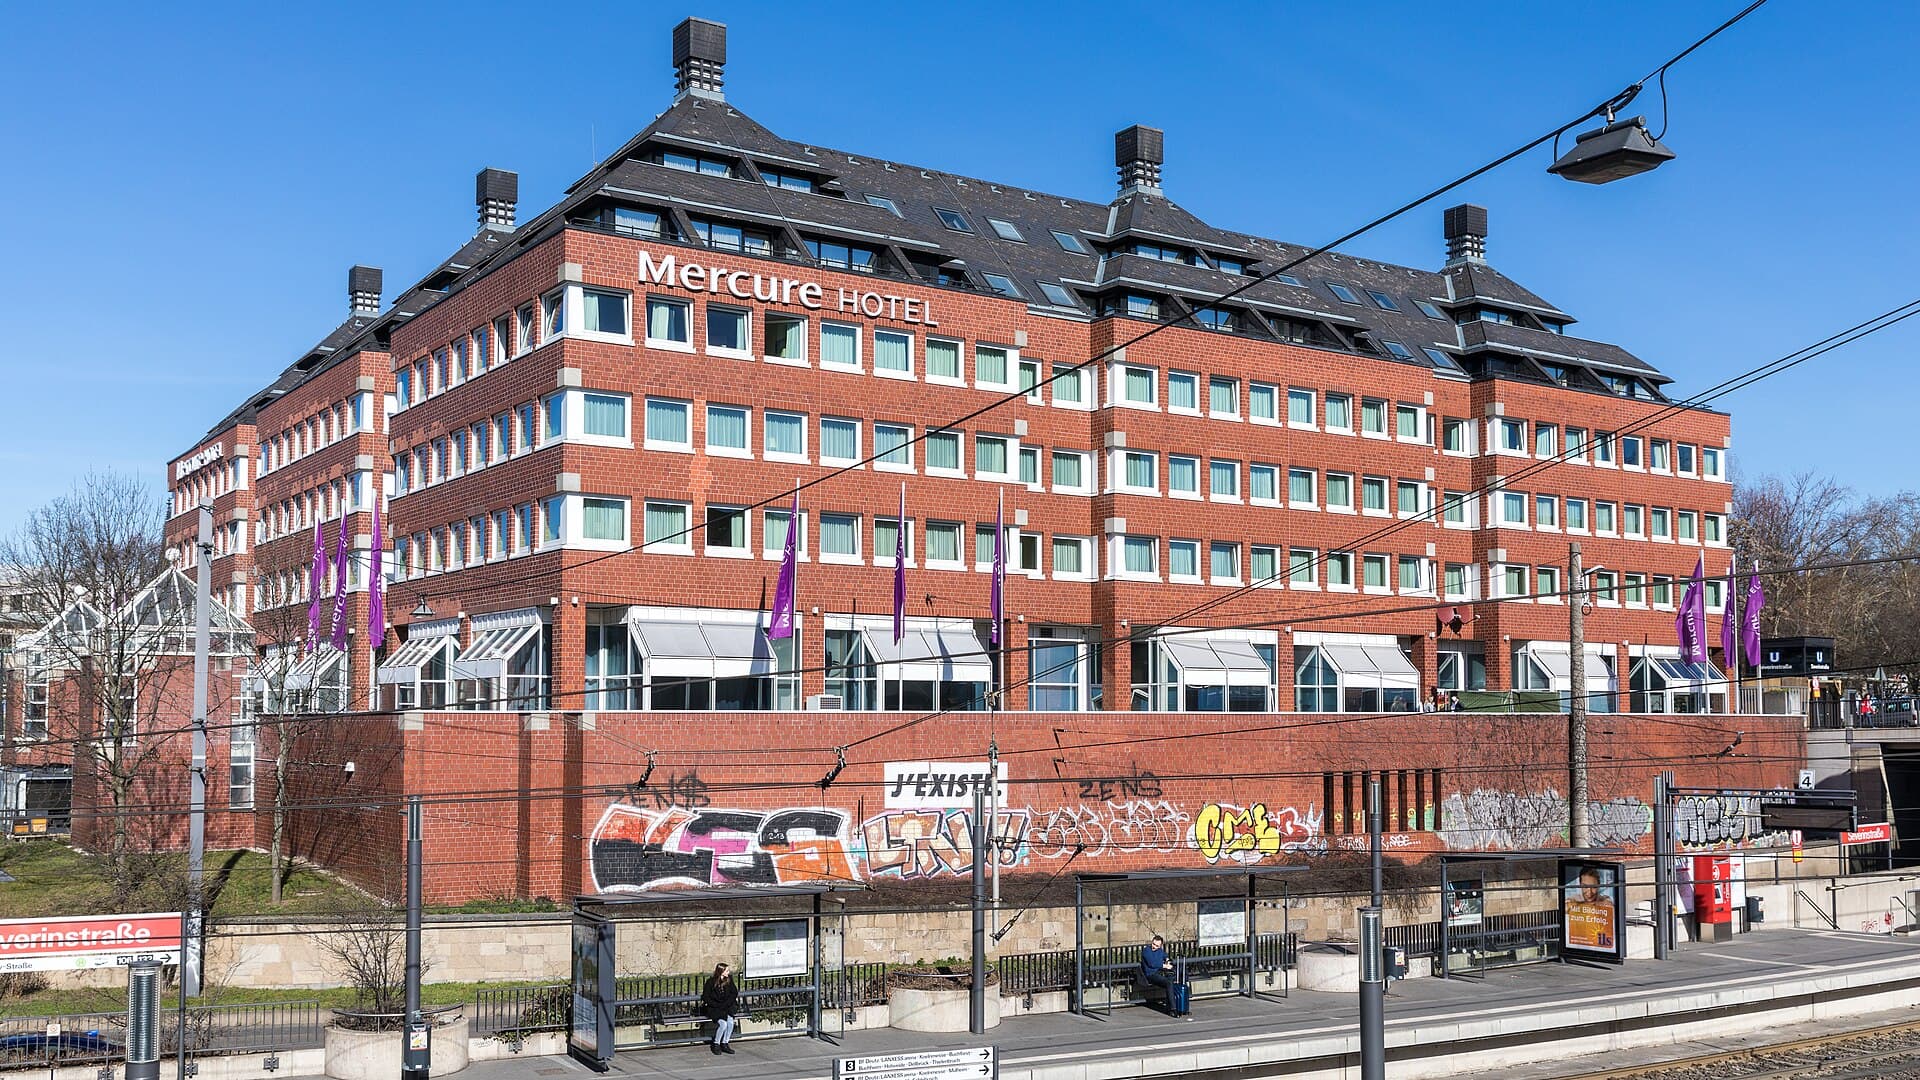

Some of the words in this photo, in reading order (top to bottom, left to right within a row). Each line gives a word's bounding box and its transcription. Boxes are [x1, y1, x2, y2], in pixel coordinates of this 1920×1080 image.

[638, 250, 823, 309] Mercure
[838, 287, 939, 326] HOTEL
[1769, 652, 1780, 663] U
[1816, 651, 1823, 663] U
[1801, 776, 1812, 787] 4
[1583, 906, 1608, 916] Bildung
